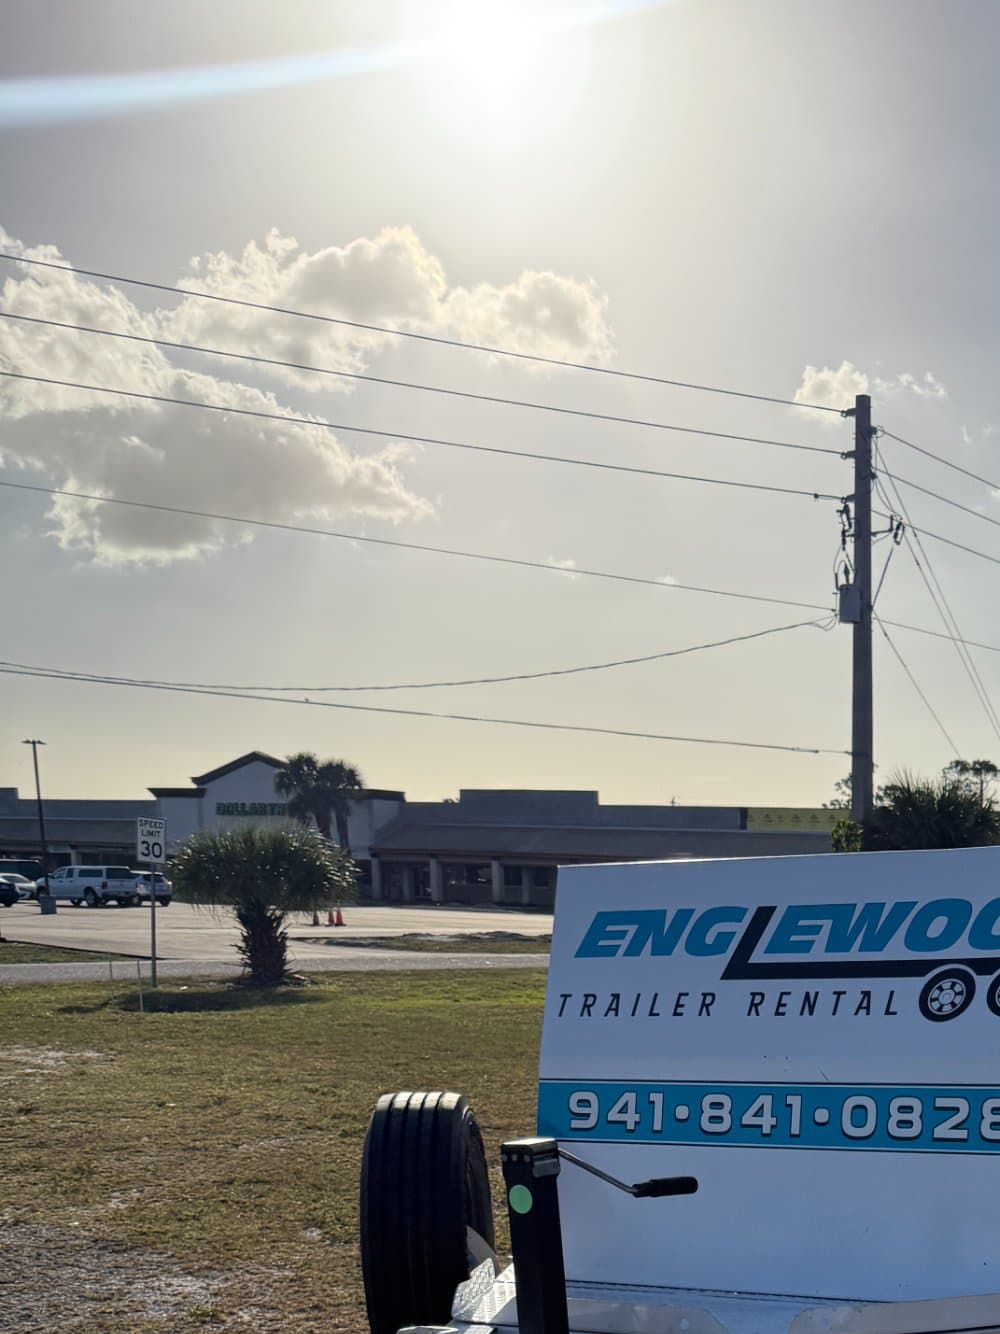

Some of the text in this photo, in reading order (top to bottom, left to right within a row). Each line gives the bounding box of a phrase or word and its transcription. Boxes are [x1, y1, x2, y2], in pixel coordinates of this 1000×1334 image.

[139, 819, 164, 829] SPEED
[141, 829, 160, 837] LIMIT
[140, 840, 162, 858] 30
[558, 989, 899, 1018] TRAILER RENTAL
